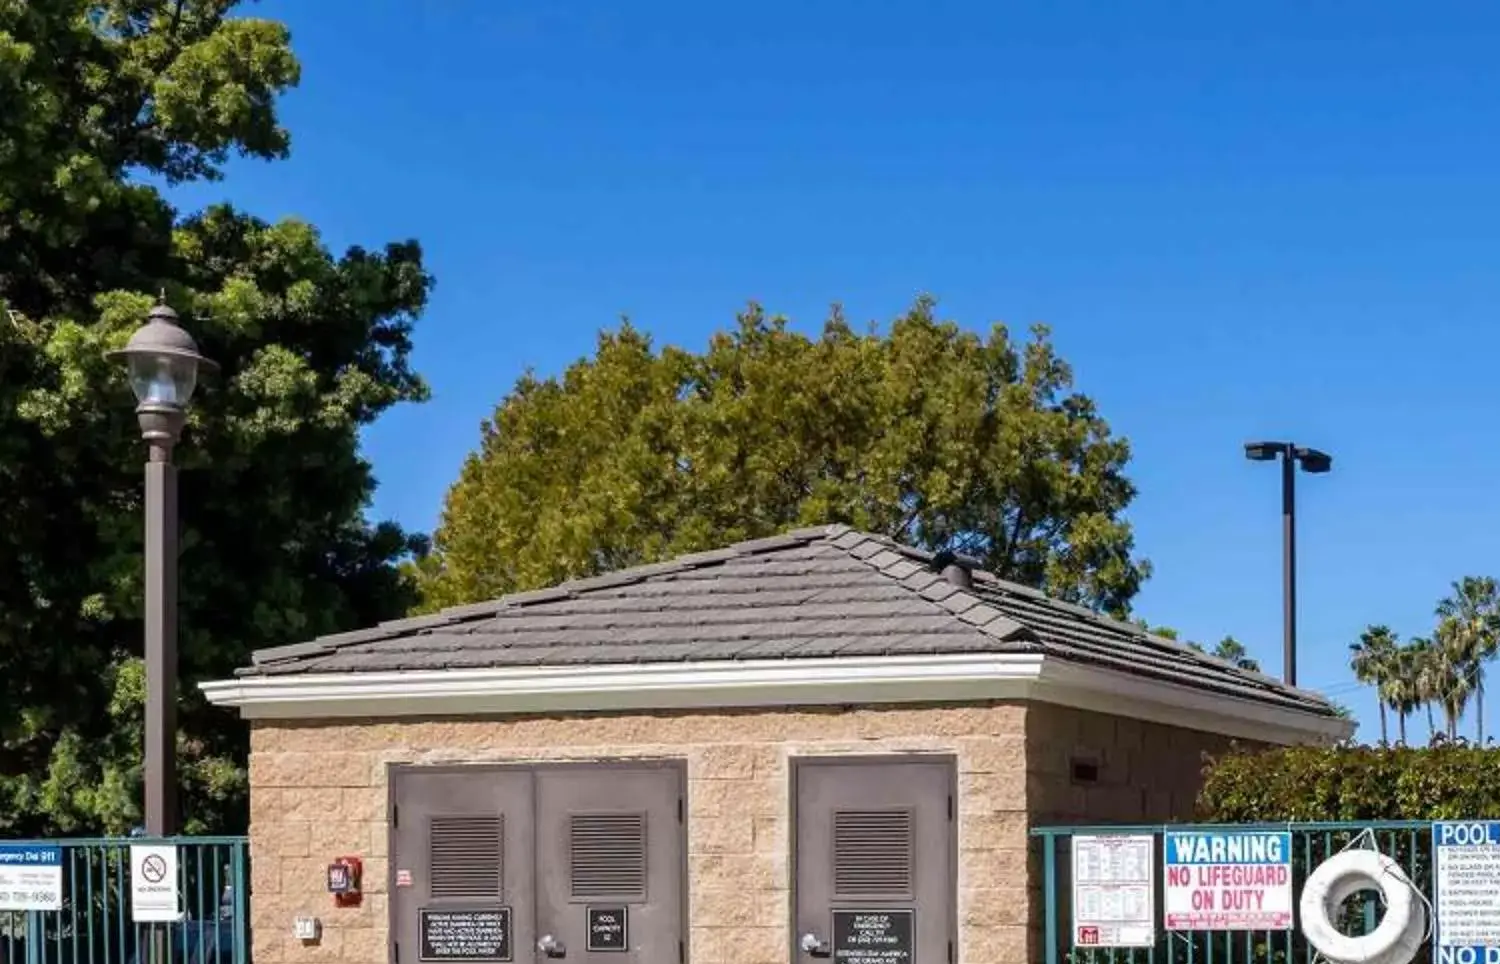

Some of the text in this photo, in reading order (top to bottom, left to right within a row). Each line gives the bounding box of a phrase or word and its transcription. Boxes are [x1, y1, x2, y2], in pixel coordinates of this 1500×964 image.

[1441, 822, 1496, 845] POOL
[1174, 836, 1281, 862] WARNING
[1168, 866, 1287, 887] NO LIFEGUARD
[1191, 890, 1265, 910] ON DUTY
